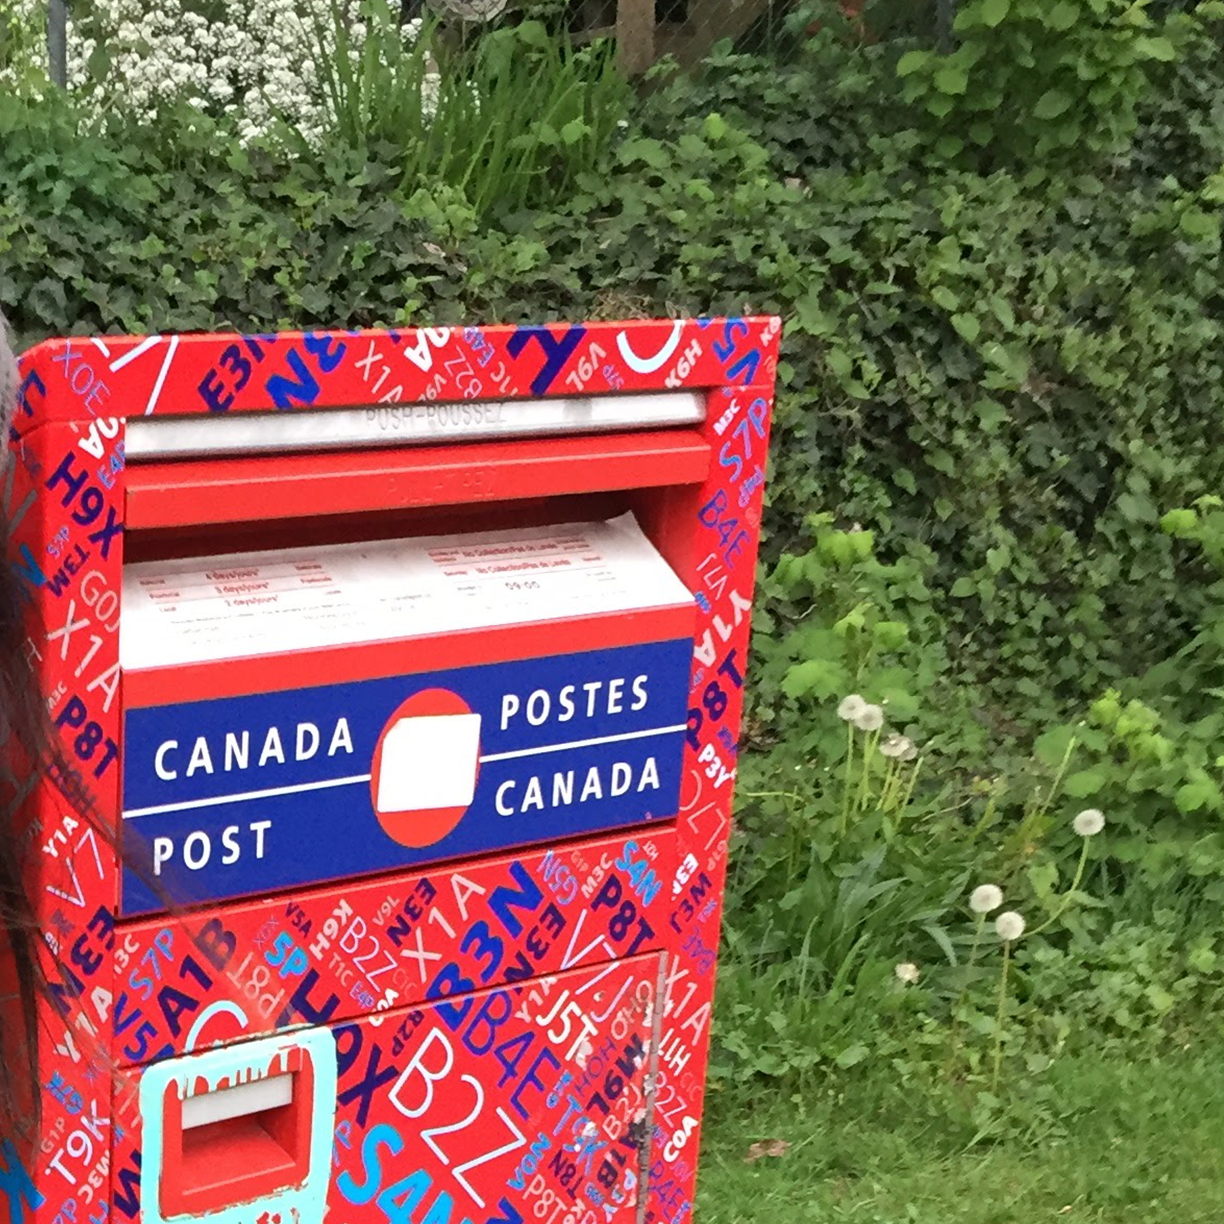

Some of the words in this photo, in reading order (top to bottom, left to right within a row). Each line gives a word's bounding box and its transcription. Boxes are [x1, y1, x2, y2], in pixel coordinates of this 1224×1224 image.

[44, 451, 125, 564] H9X
[44, 598, 122, 714] X1A
[54, 694, 120, 780] P8T
[500, 673, 649, 731] POSTES
[686, 647, 743, 753] P8T
[154, 716, 355, 782] CANADA
[494, 756, 661, 817] CANADA
[42, 814, 80, 860] Y1A
[153, 819, 274, 877] POST
[339, 915, 398, 993] B2Z
[400, 872, 487, 984] X1A
[425, 859, 545, 1033] B3N
[590, 873, 656, 958] P8T
[128, 927, 175, 1002] S7P
[156, 917, 238, 1040] A1B
[460, 987, 562, 1121] B4E
[535, 989, 599, 1062] J5T
[44, 1098, 112, 1186] T9K
[387, 1026, 527, 1209] B2Z
